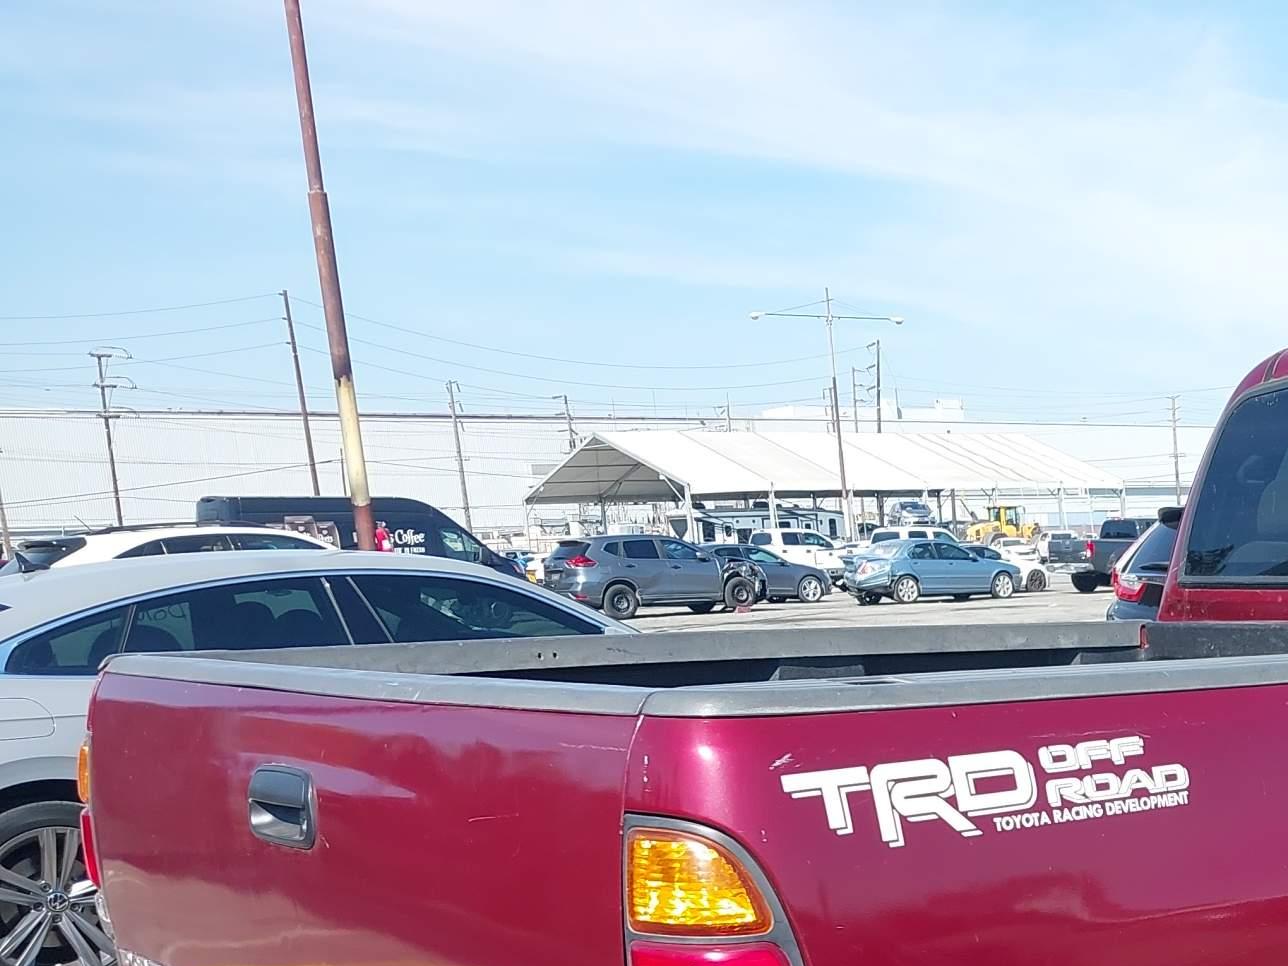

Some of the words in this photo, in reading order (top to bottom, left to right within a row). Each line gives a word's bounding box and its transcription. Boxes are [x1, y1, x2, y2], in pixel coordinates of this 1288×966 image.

[394, 529, 425, 546] Coffee
[1037, 735, 1144, 774] OFF
[780, 750, 1038, 848] TRD
[1045, 763, 1190, 807] ROAD
[993, 810, 1051, 832] TOYOTA
[1053, 802, 1104, 824] RACING
[1105, 790, 1190, 817] DEVELOPMENT
